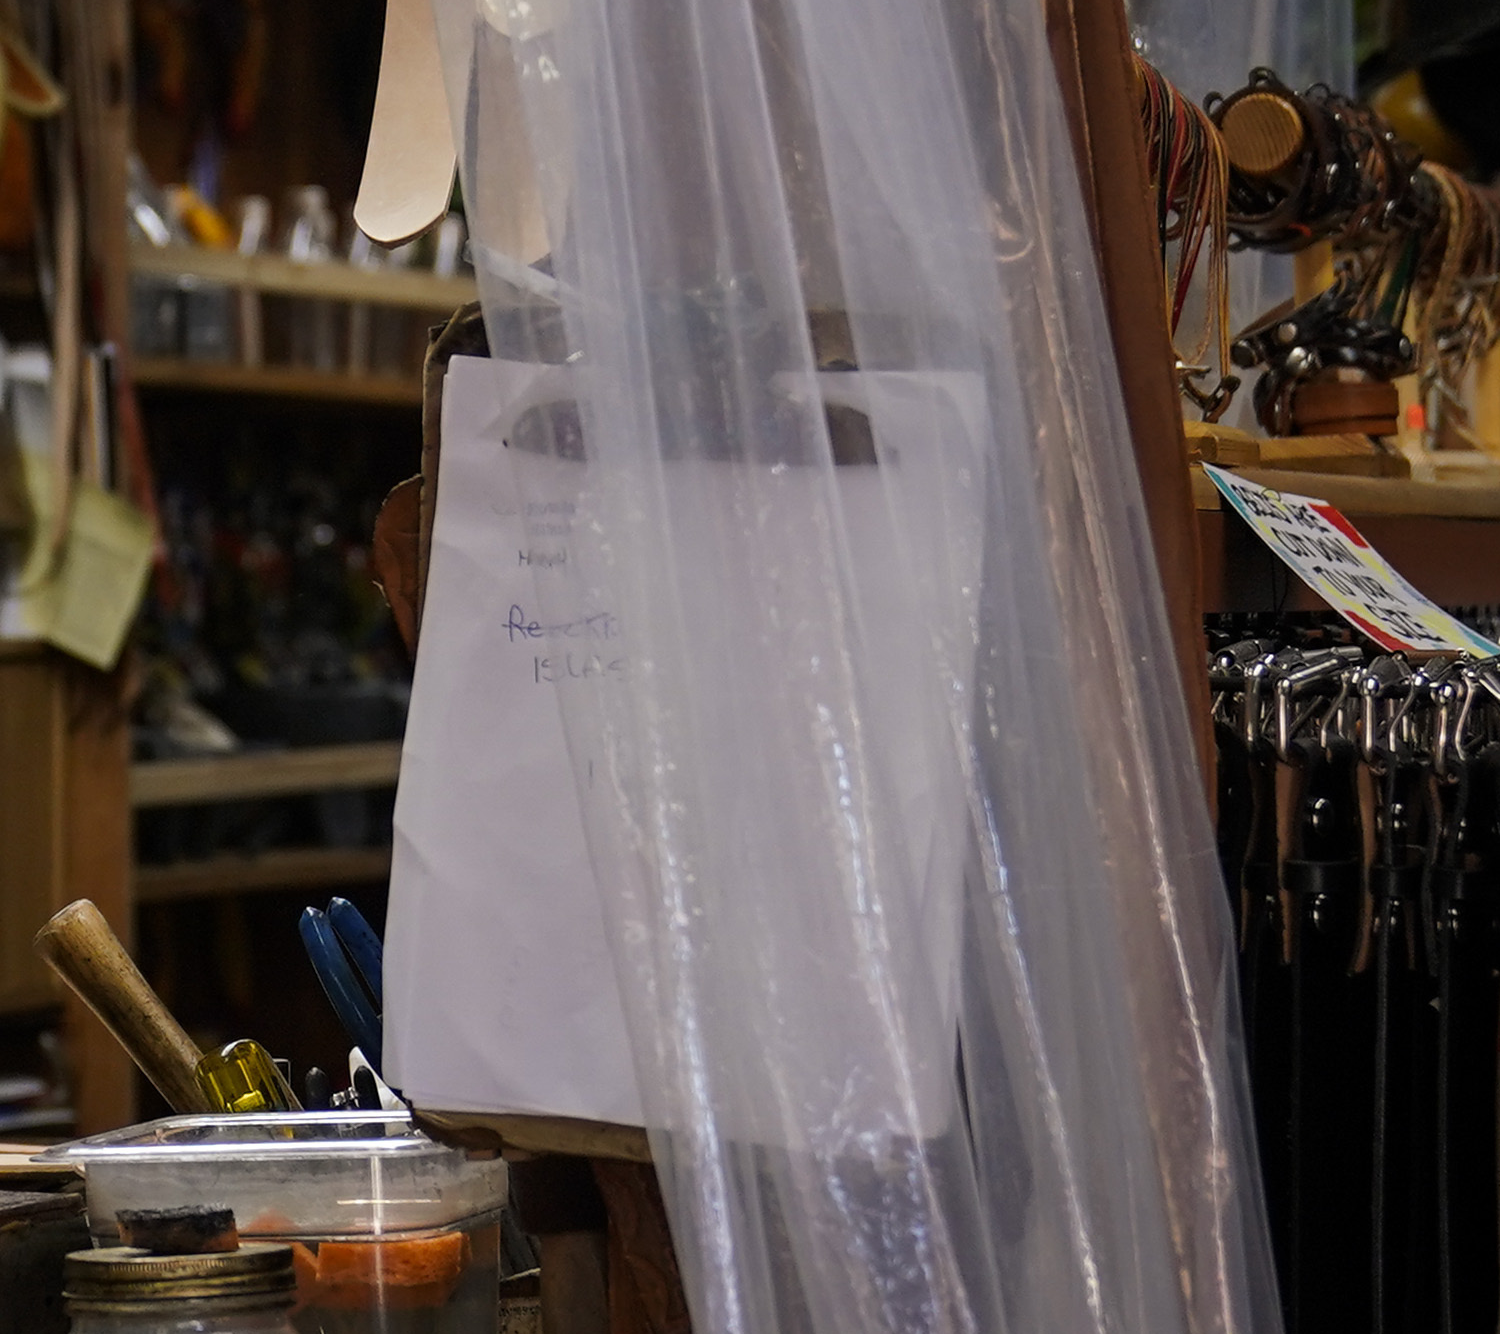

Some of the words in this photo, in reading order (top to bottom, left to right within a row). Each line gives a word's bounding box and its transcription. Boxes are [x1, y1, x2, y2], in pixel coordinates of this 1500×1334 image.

[1230, 484, 1292, 524] BELTS
[1282, 503, 1331, 533] ARE
[1270, 526, 1316, 558] CUT
[1300, 533, 1365, 567] DOWN
[1312, 566, 1356, 597] TO
[1333, 569, 1407, 605] YOUR
[1363, 603, 1448, 643] SIZE
